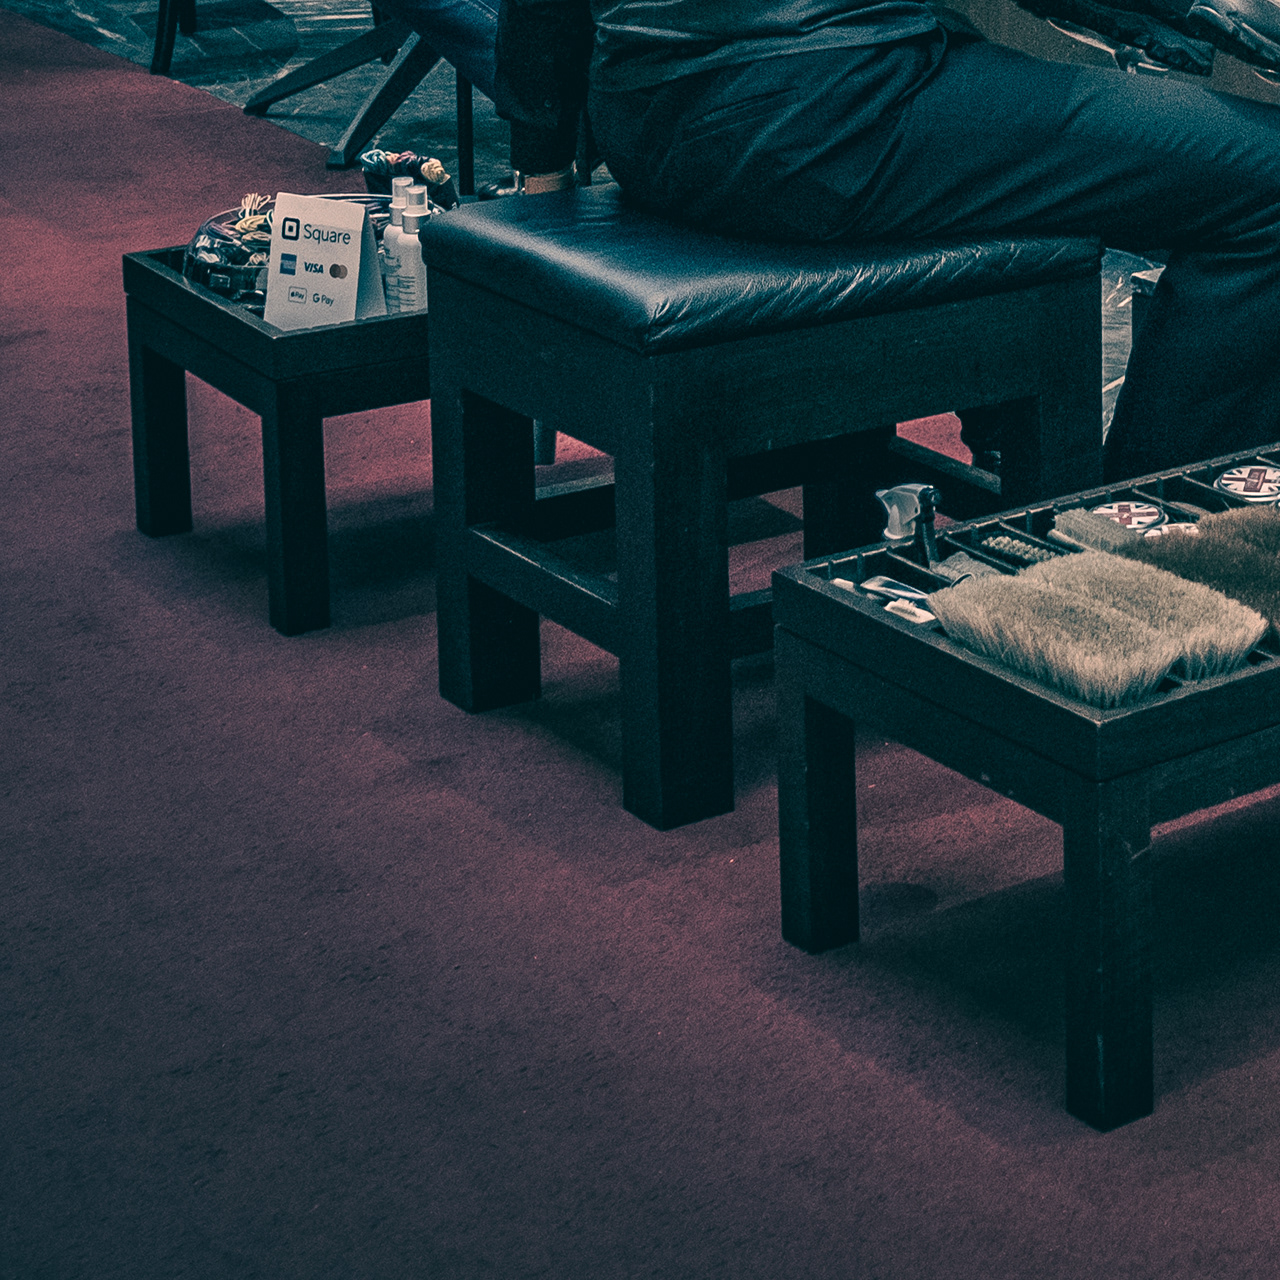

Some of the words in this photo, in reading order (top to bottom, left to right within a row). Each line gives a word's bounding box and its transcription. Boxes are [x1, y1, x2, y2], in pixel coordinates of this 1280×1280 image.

[303, 223, 351, 246] Square
[303, 261, 325, 274] VISA
[312, 292, 321, 303] G
[321, 294, 335, 307] Pay
